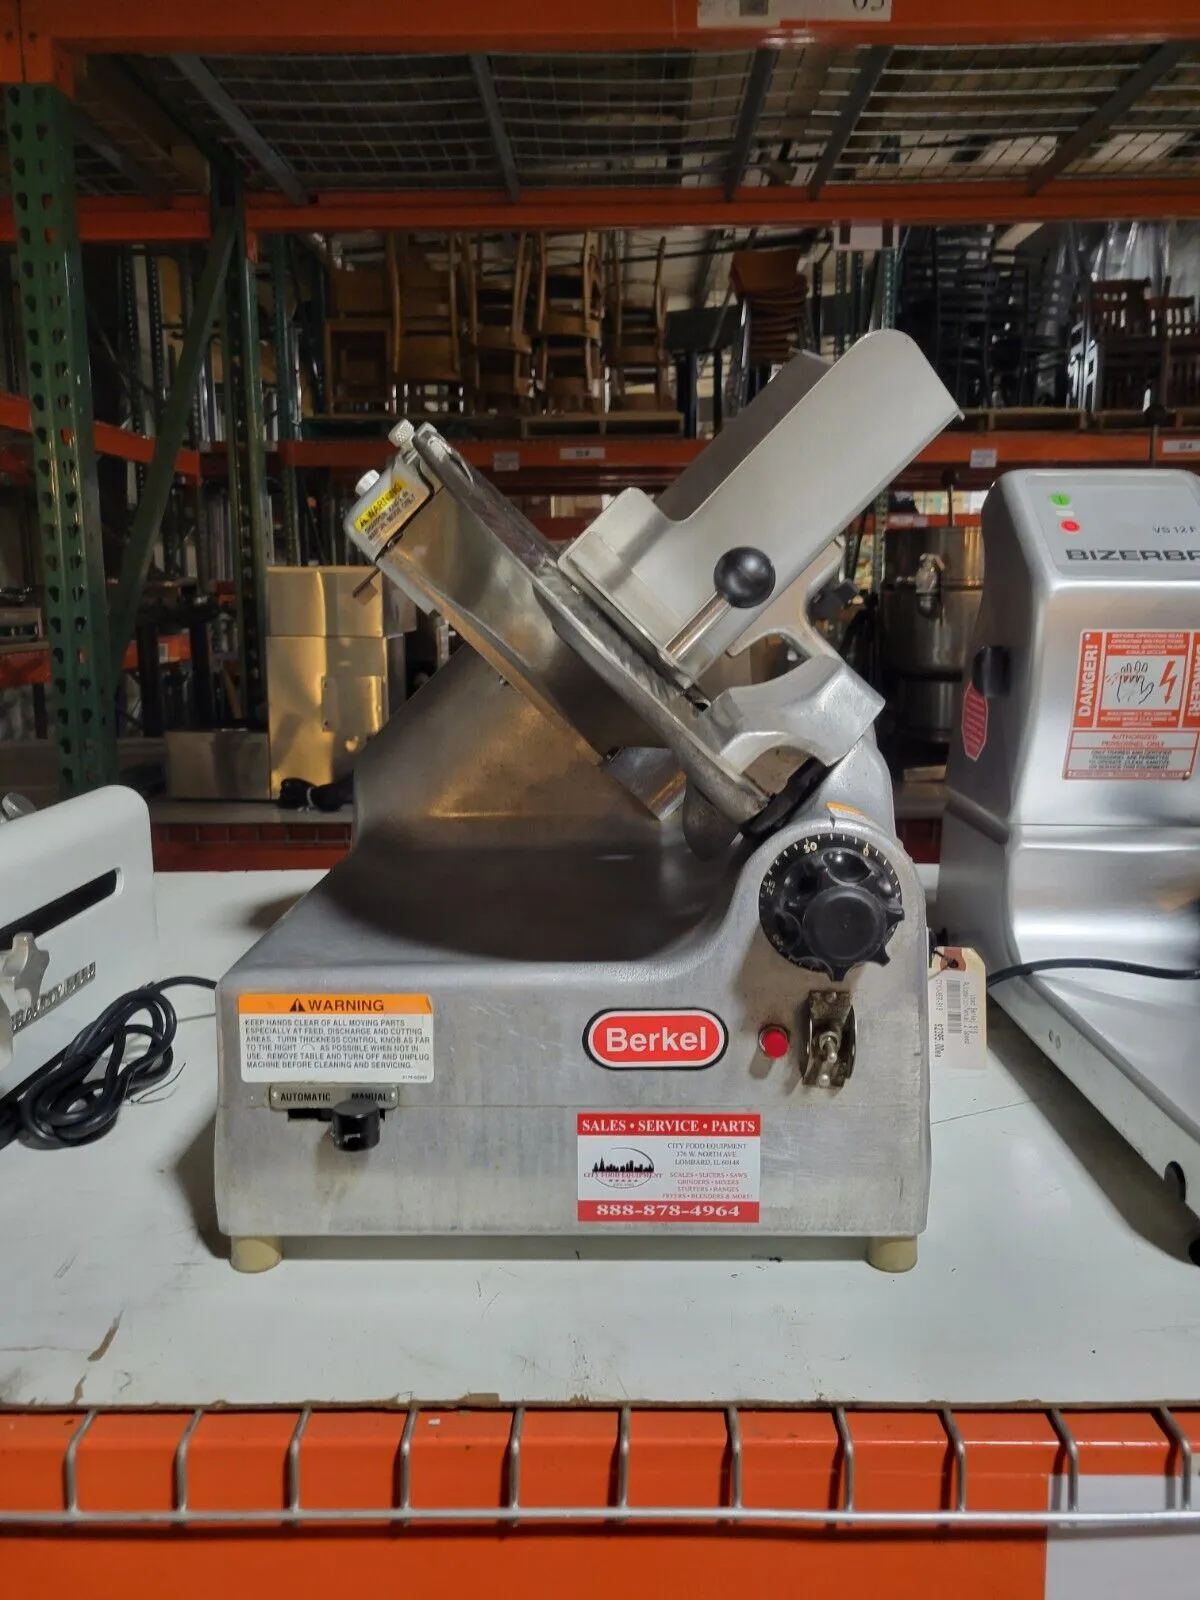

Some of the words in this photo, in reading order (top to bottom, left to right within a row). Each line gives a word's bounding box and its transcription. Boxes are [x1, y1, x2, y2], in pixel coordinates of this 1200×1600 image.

[1078, 644, 1098, 717] DANGER!
[308, 999, 384, 1012] WARNING
[606, 1026, 707, 1052] Berkel
[246, 1044, 256, 1052] TO
[258, 1044, 272, 1052] THE
[274, 1044, 296, 1052] RIGHT
[320, 1044, 330, 1052] AS
[332, 1044, 368, 1052] POSSIBLE
[371, 1044, 392, 1052] WHEN
[394, 1044, 409, 1052] NOT
[411, 1044, 419, 1052] IN
[247, 1061, 280, 1069] MACHINE
[282, 1061, 312, 1069] BEFORE
[314, 1061, 352, 1069] CLEANING
[354, 1061, 369, 1069] AND
[371, 1061, 413, 1069] SERVICING.
[281, 1092, 331, 1101] AUTOMATIC
[582, 1120, 626, 1132] SALES
[638, 1120, 699, 1132] SERVICE
[712, 1120, 755, 1132] PARTS
[596, 1204, 740, 1217] 888-878-4964
